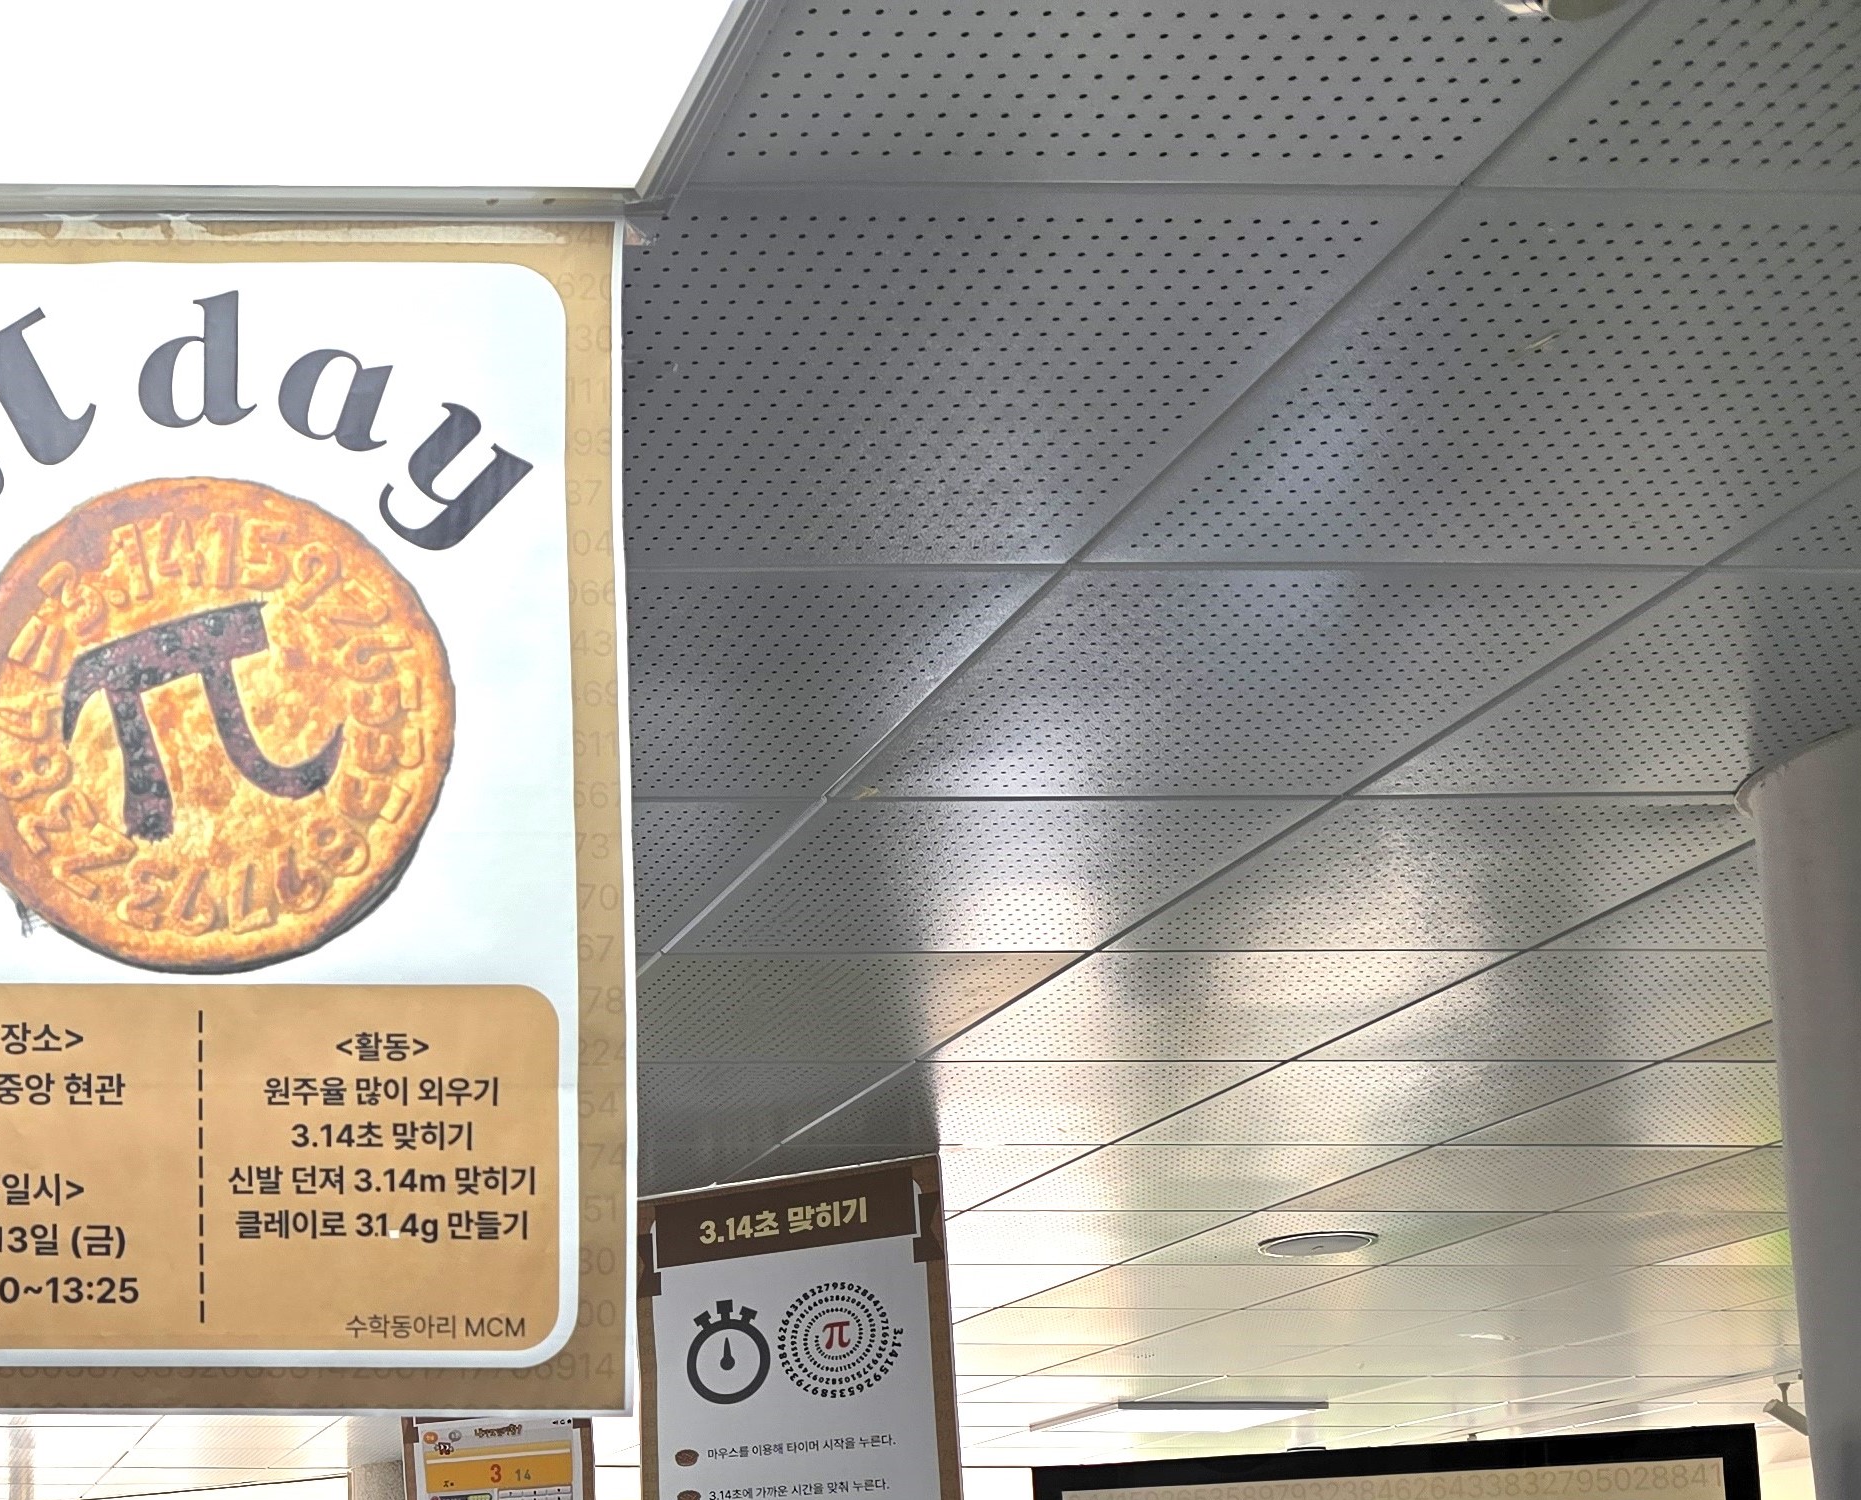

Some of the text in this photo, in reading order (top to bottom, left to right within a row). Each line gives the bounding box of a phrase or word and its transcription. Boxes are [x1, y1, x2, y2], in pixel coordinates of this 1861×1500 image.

[138, 290, 534, 550] day
[336, 1032, 429, 1061] <활동>
[64, 1073, 126, 1105] 현관
[264, 1077, 498, 1106] 원주율 많이 외우기
[291, 1121, 472, 1150] 3.14초 맞히기
[228, 1166, 535, 1195] 신발 던져 3.14m 맞히기
[235, 1210, 347, 1240] 클레이로
[448, 1210, 528, 1240] 만들기
[699, 1196, 868, 1245] 3.14초 맞히기
[71, 1224, 126, 1259] (금)
[345, 1315, 526, 1339] 수학동아리 MCM
[707, 1434, 896, 1460] 마우스를 이용해 타이머 시작을 누른다.
[709, 1478, 890, 1500] 3.14초에 가까운 시간을 맞춰 누른다.
